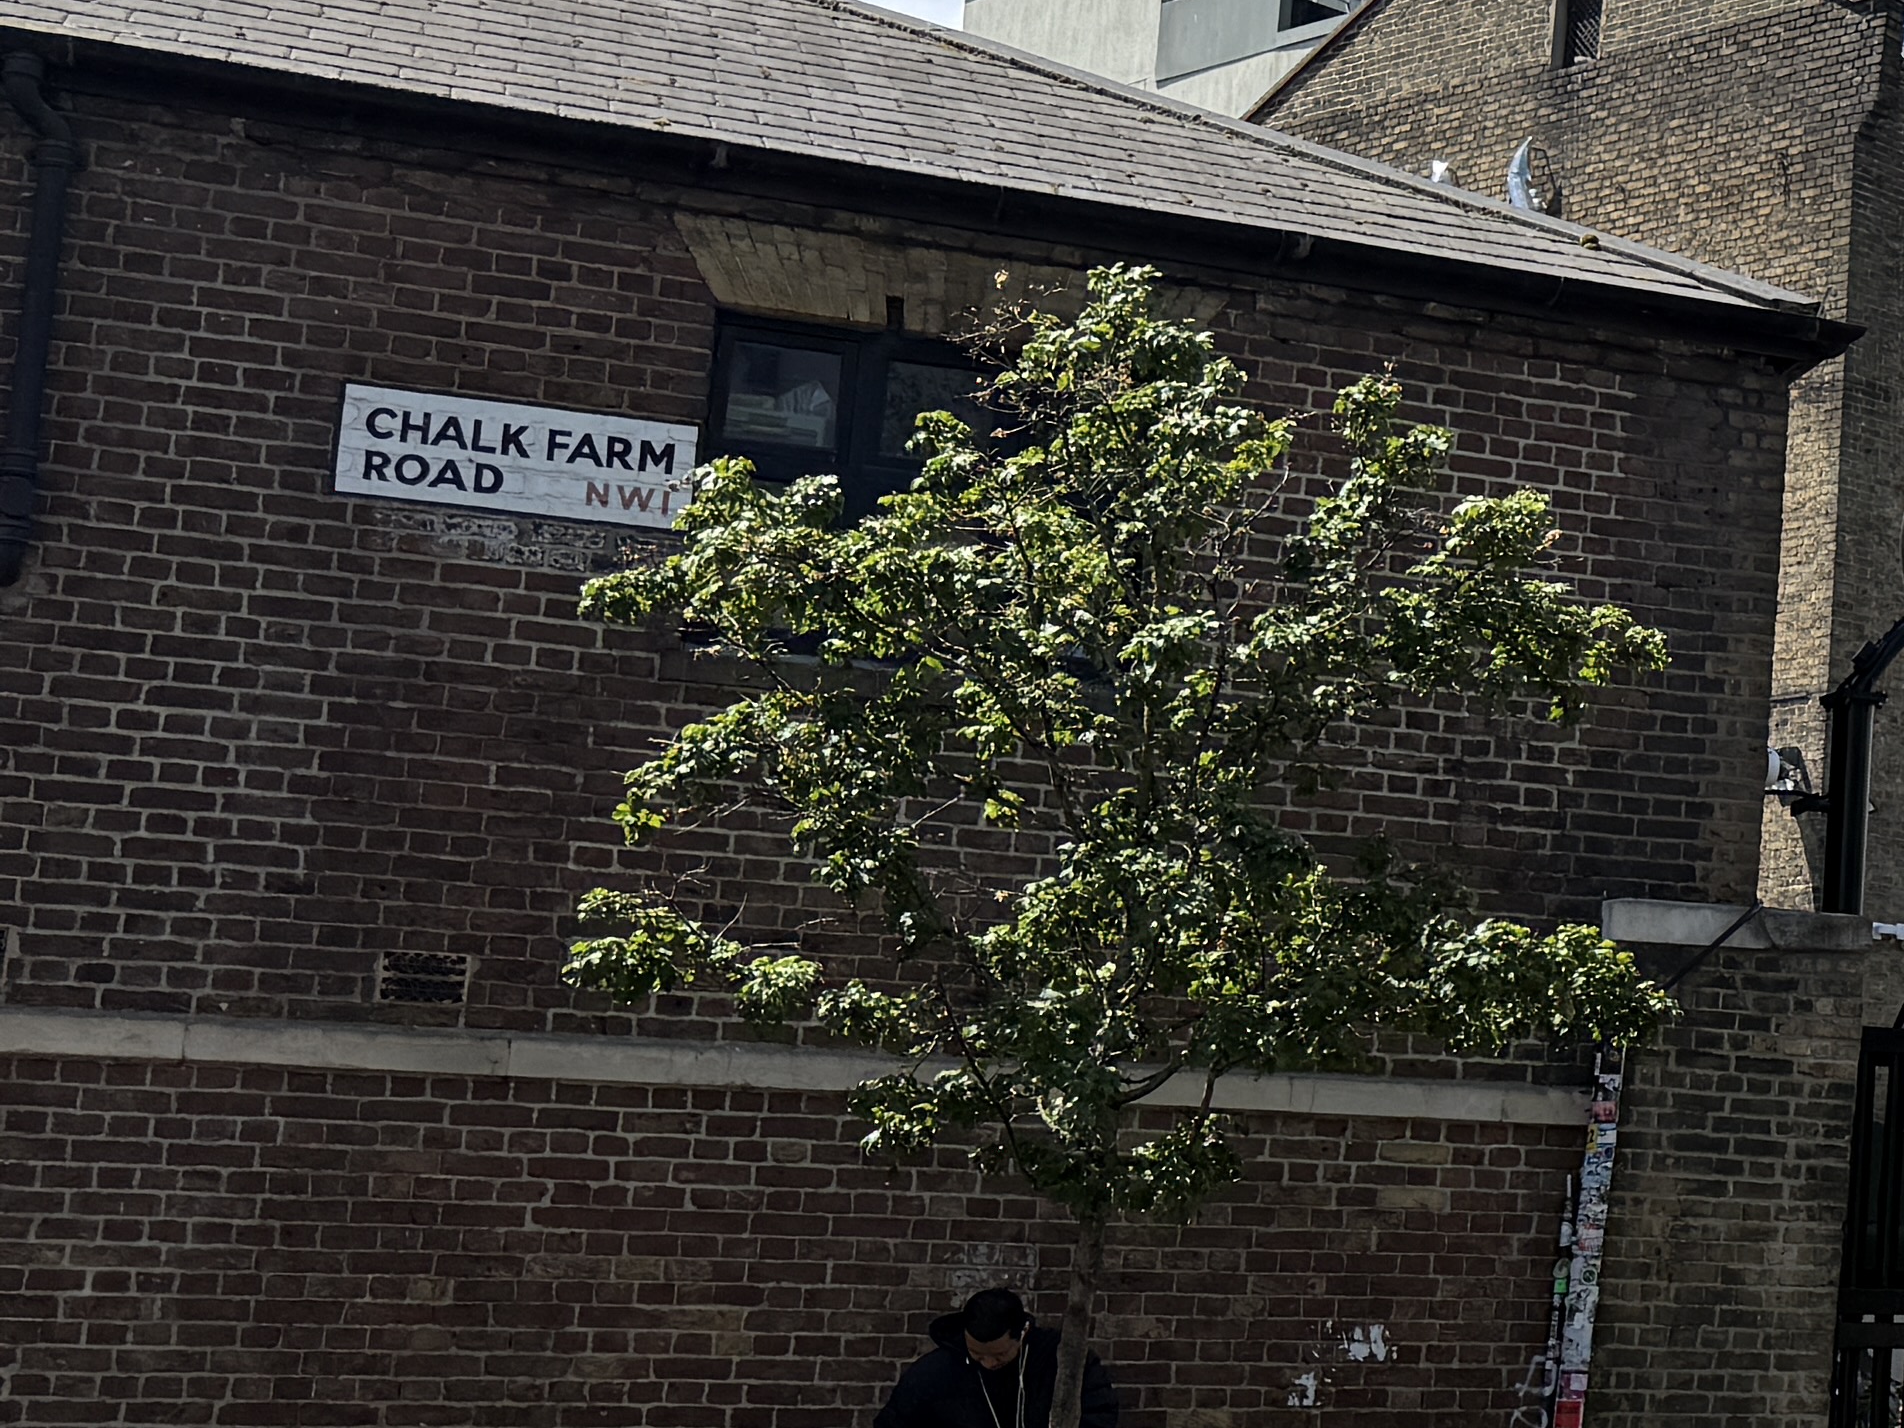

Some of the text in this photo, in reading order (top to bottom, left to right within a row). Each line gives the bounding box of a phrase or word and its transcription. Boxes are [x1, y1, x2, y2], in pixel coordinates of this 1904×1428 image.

[365, 407, 676, 475] CHALK FARM
[362, 449, 504, 494] ROAD
